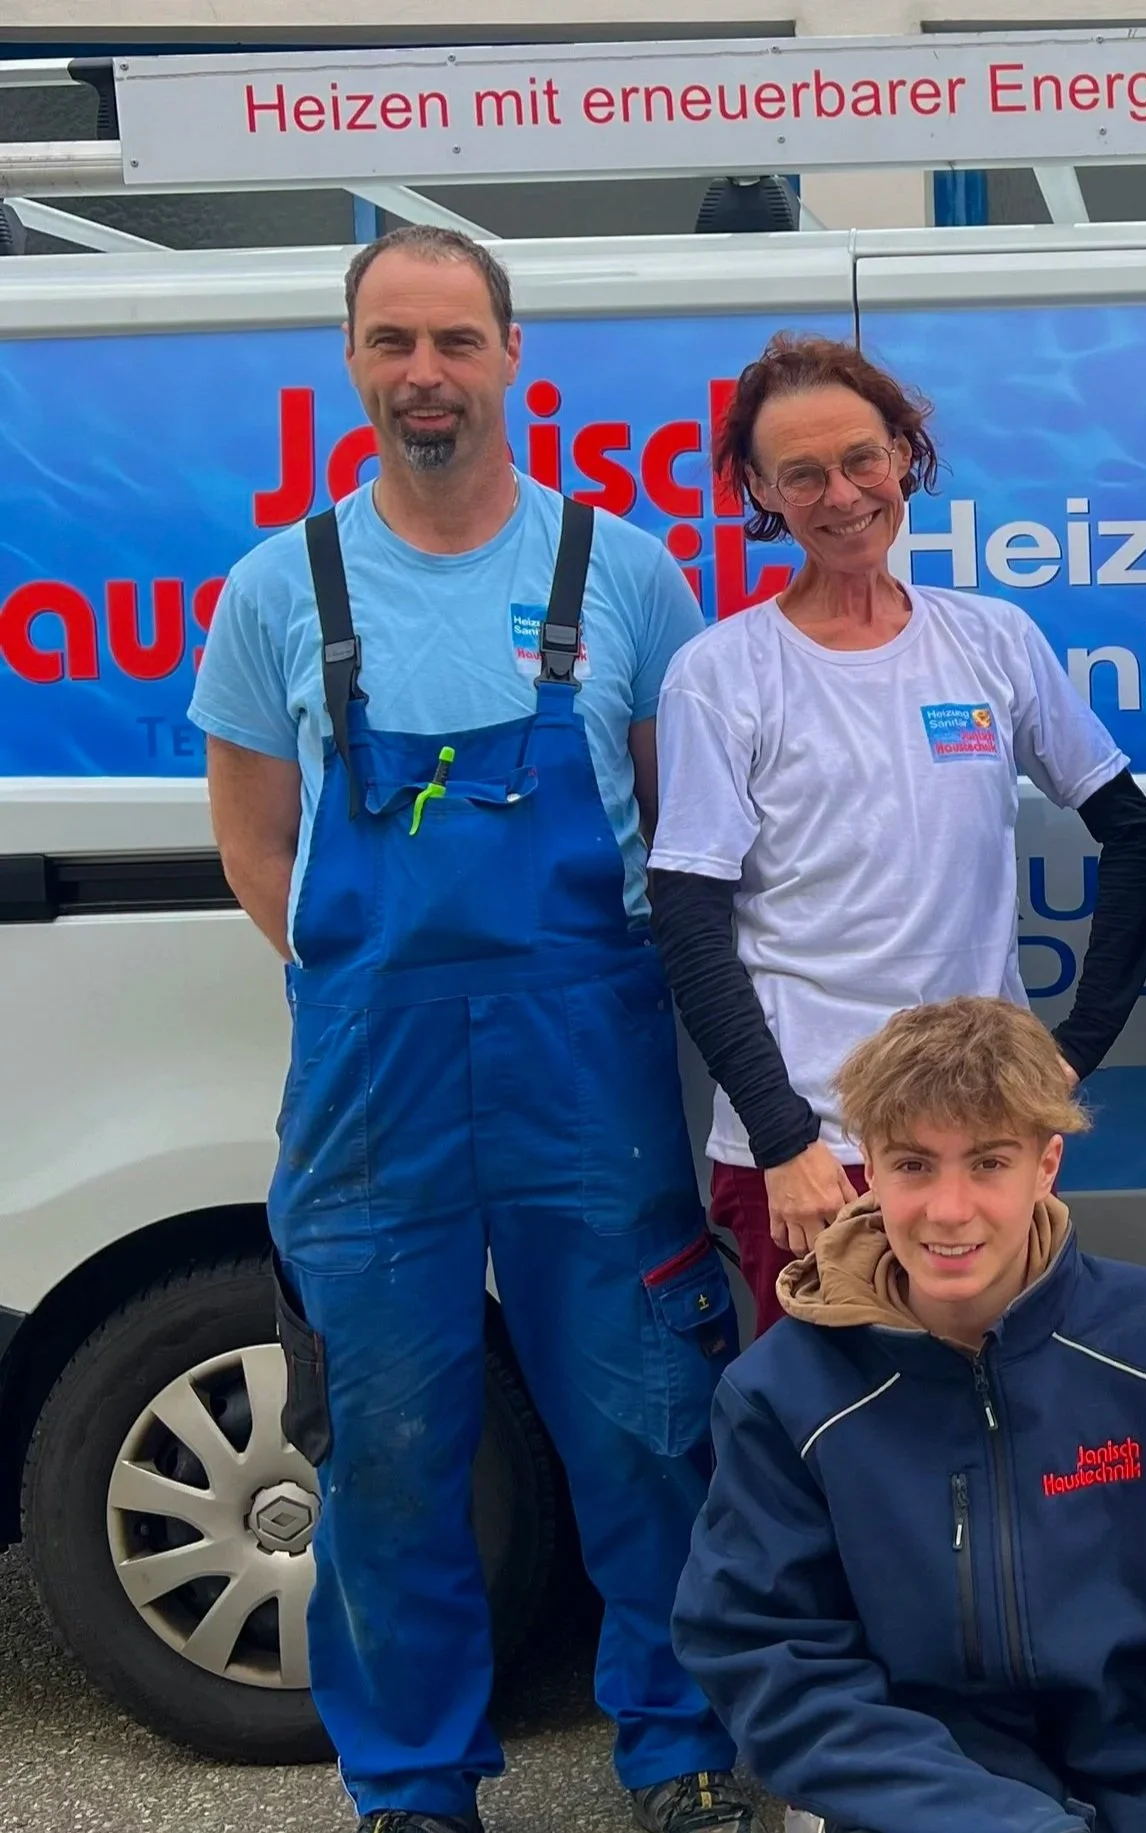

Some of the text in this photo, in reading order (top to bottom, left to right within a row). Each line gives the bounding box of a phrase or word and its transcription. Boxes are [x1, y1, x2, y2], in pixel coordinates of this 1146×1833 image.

[244, 82, 449, 133] Heizen
[474, 76, 562, 129] mit
[582, 68, 966, 124] erneuerbarer
[927, 710, 970, 719] Heizung
[928, 718, 968, 729] Sanitär
[1078, 1436, 1140, 1466] Janisch
[1042, 1459, 1141, 1497] Haustechnik
